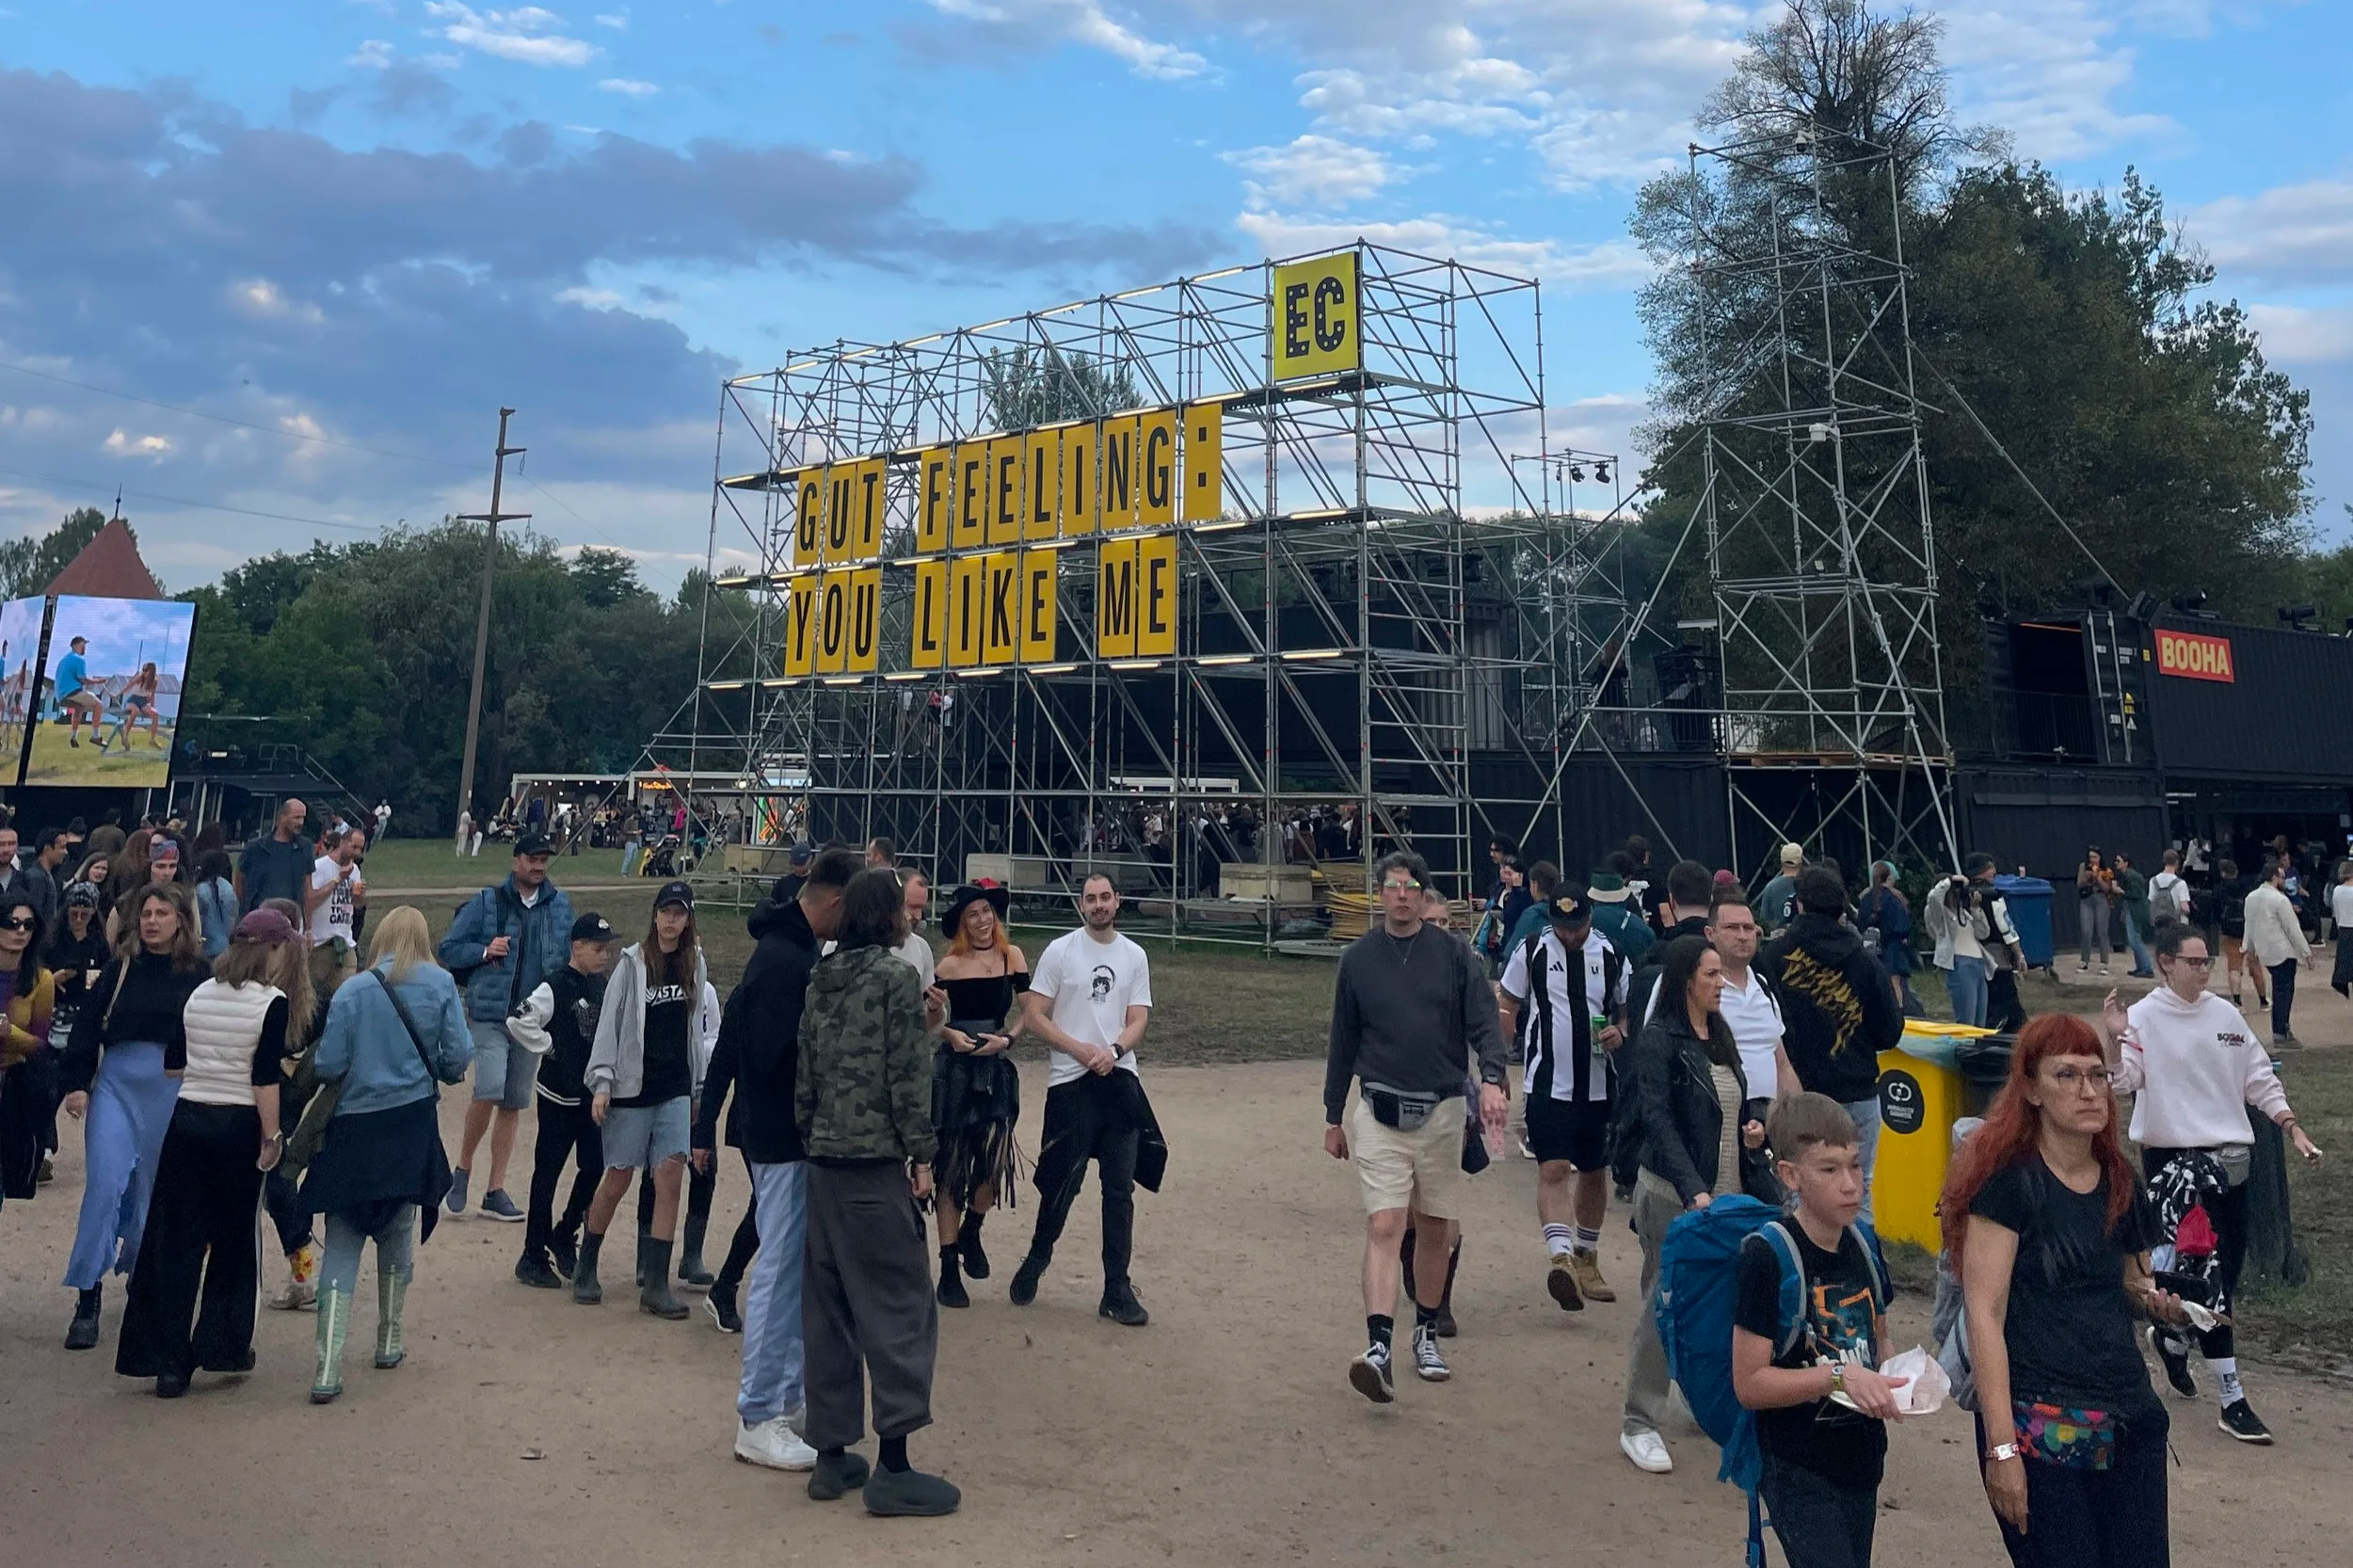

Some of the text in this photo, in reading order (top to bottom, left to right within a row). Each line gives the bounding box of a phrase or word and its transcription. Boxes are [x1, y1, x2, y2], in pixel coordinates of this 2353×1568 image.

[1286, 276, 1346, 359] EC
[800, 424, 1208, 552] GUT FEELING:
[793, 557, 1168, 662] YOU LIKE ME
[2161, 636, 2231, 676] BOOHA
